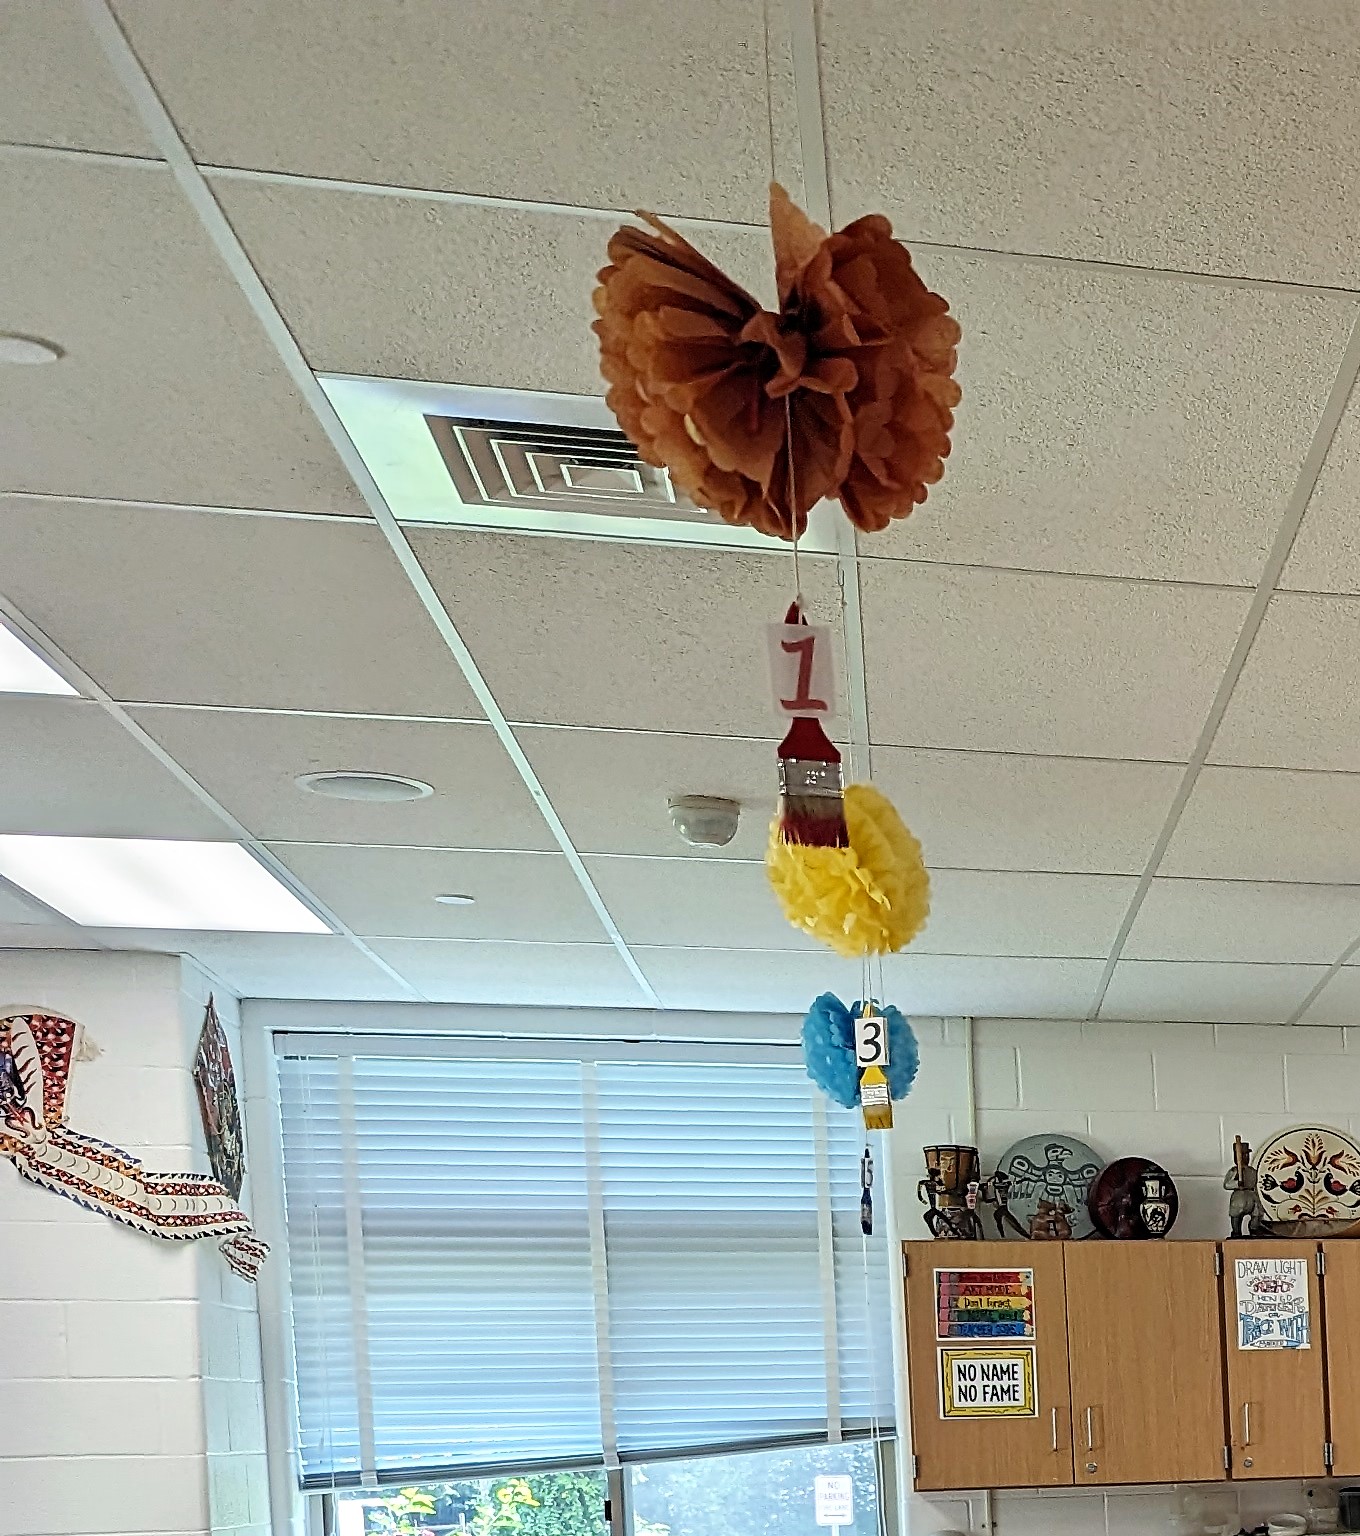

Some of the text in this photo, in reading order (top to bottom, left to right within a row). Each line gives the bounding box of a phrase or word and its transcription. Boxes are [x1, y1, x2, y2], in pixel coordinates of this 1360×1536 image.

[780, 635, 828, 712] 1
[859, 1022, 881, 1063] 3
[1237, 1260, 1306, 1278] DRAW LIGHT
[957, 1363, 1019, 1382] NO NAME
[958, 1384, 1020, 1403] NO FAME
